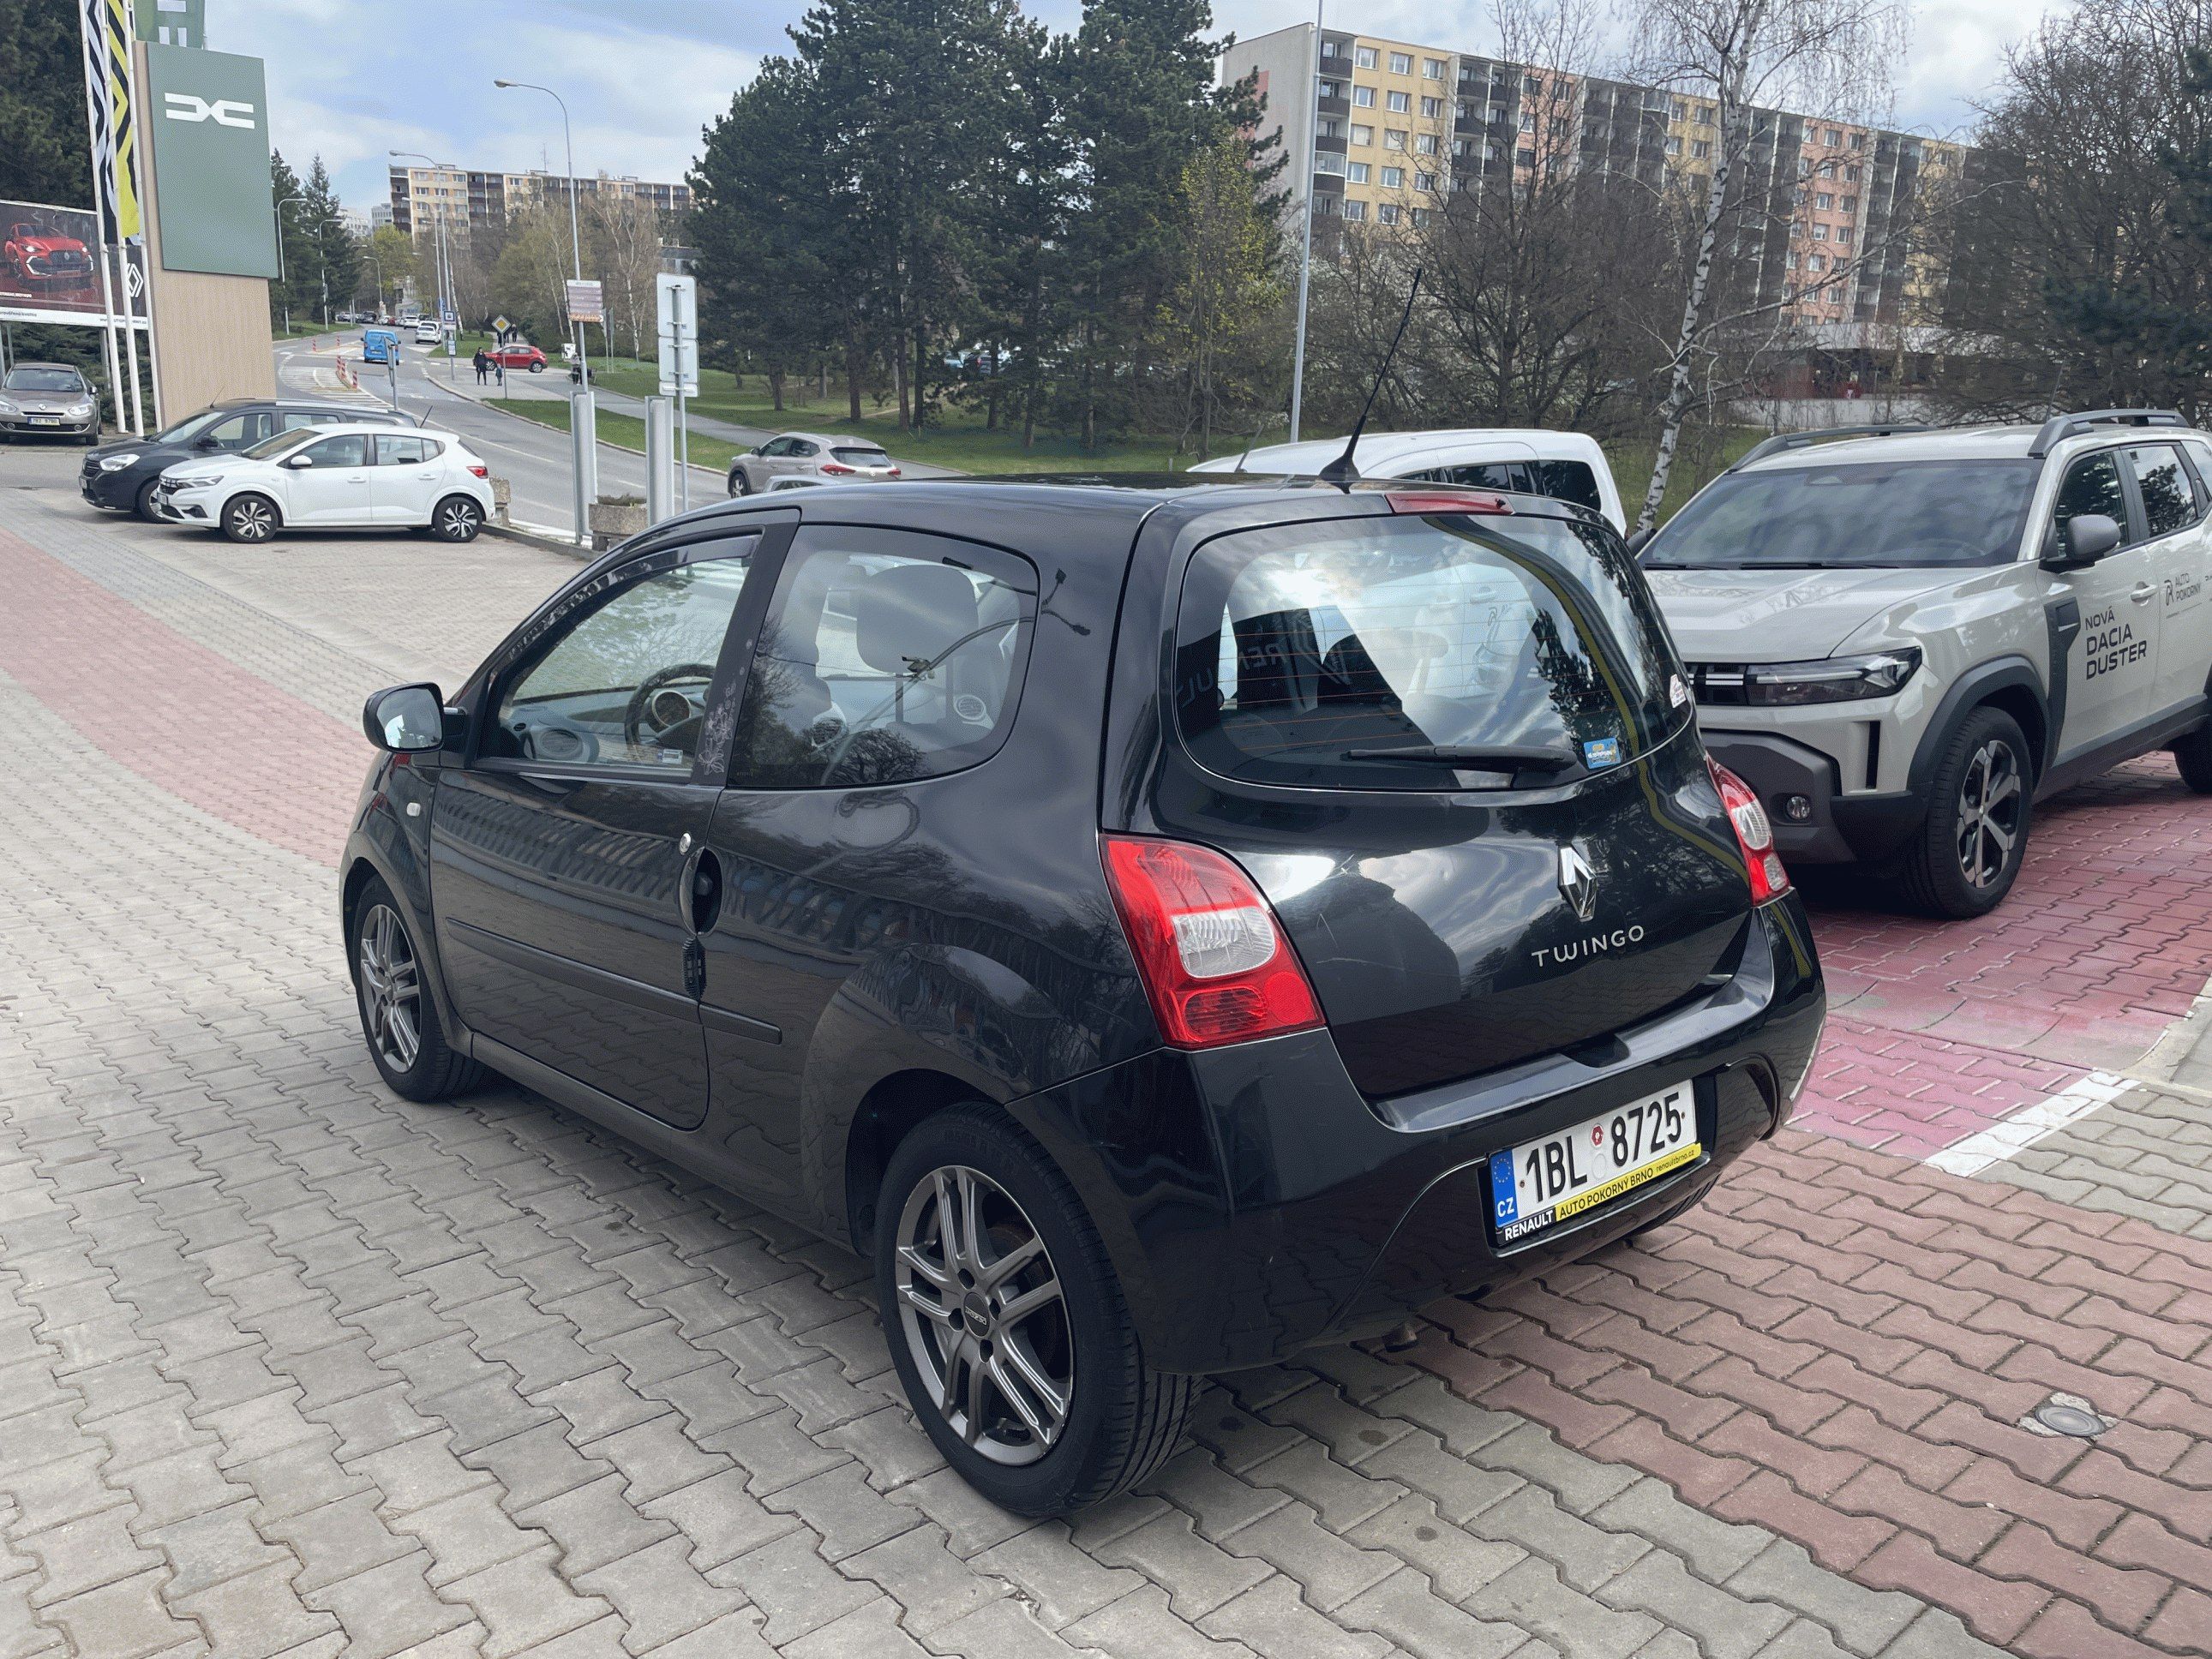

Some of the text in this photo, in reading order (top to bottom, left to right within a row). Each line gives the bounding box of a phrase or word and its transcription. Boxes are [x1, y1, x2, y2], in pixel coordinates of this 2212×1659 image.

[2085, 606, 2115, 631] NOVÁ
[2086, 623, 2132, 656] DACIA
[2086, 640, 2147, 680] DUSTER
[1532, 925, 1644, 967] TWINGO
[1526, 1092, 1681, 1202] 1BL 8725
[1560, 1149, 1694, 1219] AUTO POKORNÝ BRNO renaultbrno.cz
[1497, 1197, 1514, 1218] CZ
[1505, 1210, 1553, 1241] RENAULT
